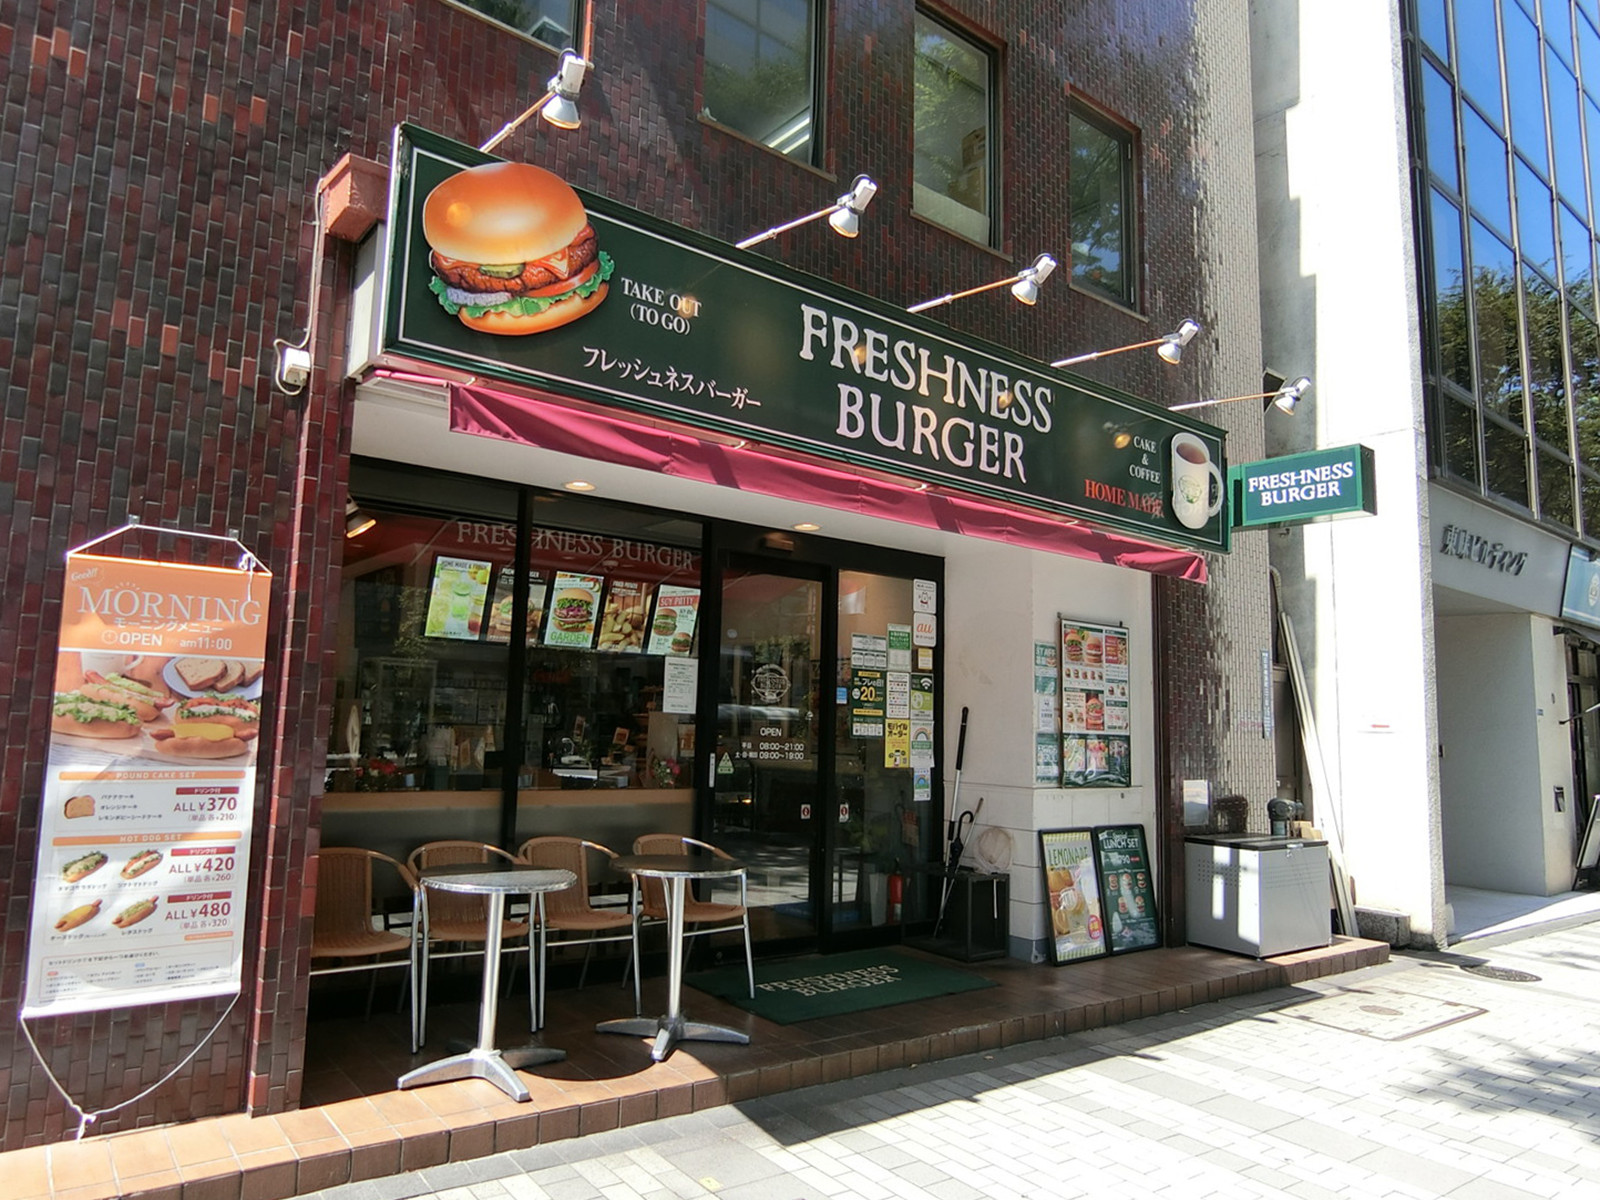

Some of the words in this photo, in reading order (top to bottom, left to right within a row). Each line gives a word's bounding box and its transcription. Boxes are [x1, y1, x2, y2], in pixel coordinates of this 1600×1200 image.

[621, 277, 664, 306] TAKE
[669, 293, 701, 317] OUT
[631, 302, 659, 326] (TO
[661, 312, 690, 335] GO)
[799, 303, 1052, 433] FRESHNESS
[583, 346, 762, 410] フレッシュネスバーガー
[836, 383, 1027, 484] BURGER
[1133, 435, 1157, 454] CAKE
[1141, 453, 1149, 466] &
[1129, 464, 1161, 484] COFFEE
[1248, 461, 1354, 493] FRESHNESS
[1084, 479, 1126, 510] HOME
[1261, 481, 1341, 506] BURGER
[612, 538, 694, 571] BURGER
[78, 586, 261, 626] MORNING
[114, 616, 224, 634] モーニングメニュー
[916, 623, 933, 634] au
[120, 631, 163, 646] OPEN
[551, 631, 589, 643] GARDEN
[760, 727, 782, 737] OPEN
[887, 722, 908, 731] モバイル
[887, 730, 908, 738] オーダー
[116, 771, 149, 780] POUND
[152, 771, 176, 779] CAKE
[173, 802, 196, 812] ALL
[199, 797, 237, 812] ¥370
[120, 835, 139, 843] HOT
[142, 834, 161, 842] DOG
[1127, 838, 1138, 848] SET
[169, 865, 191, 874] ALL
[194, 857, 235, 873] ¥420
[1048, 846, 1088, 866] LEMONADE
[165, 910, 187, 921] ALL
[190, 902, 231, 918] ¥480
[755, 964, 899, 992] FRESHNESS
[794, 975, 901, 997] BURGER
